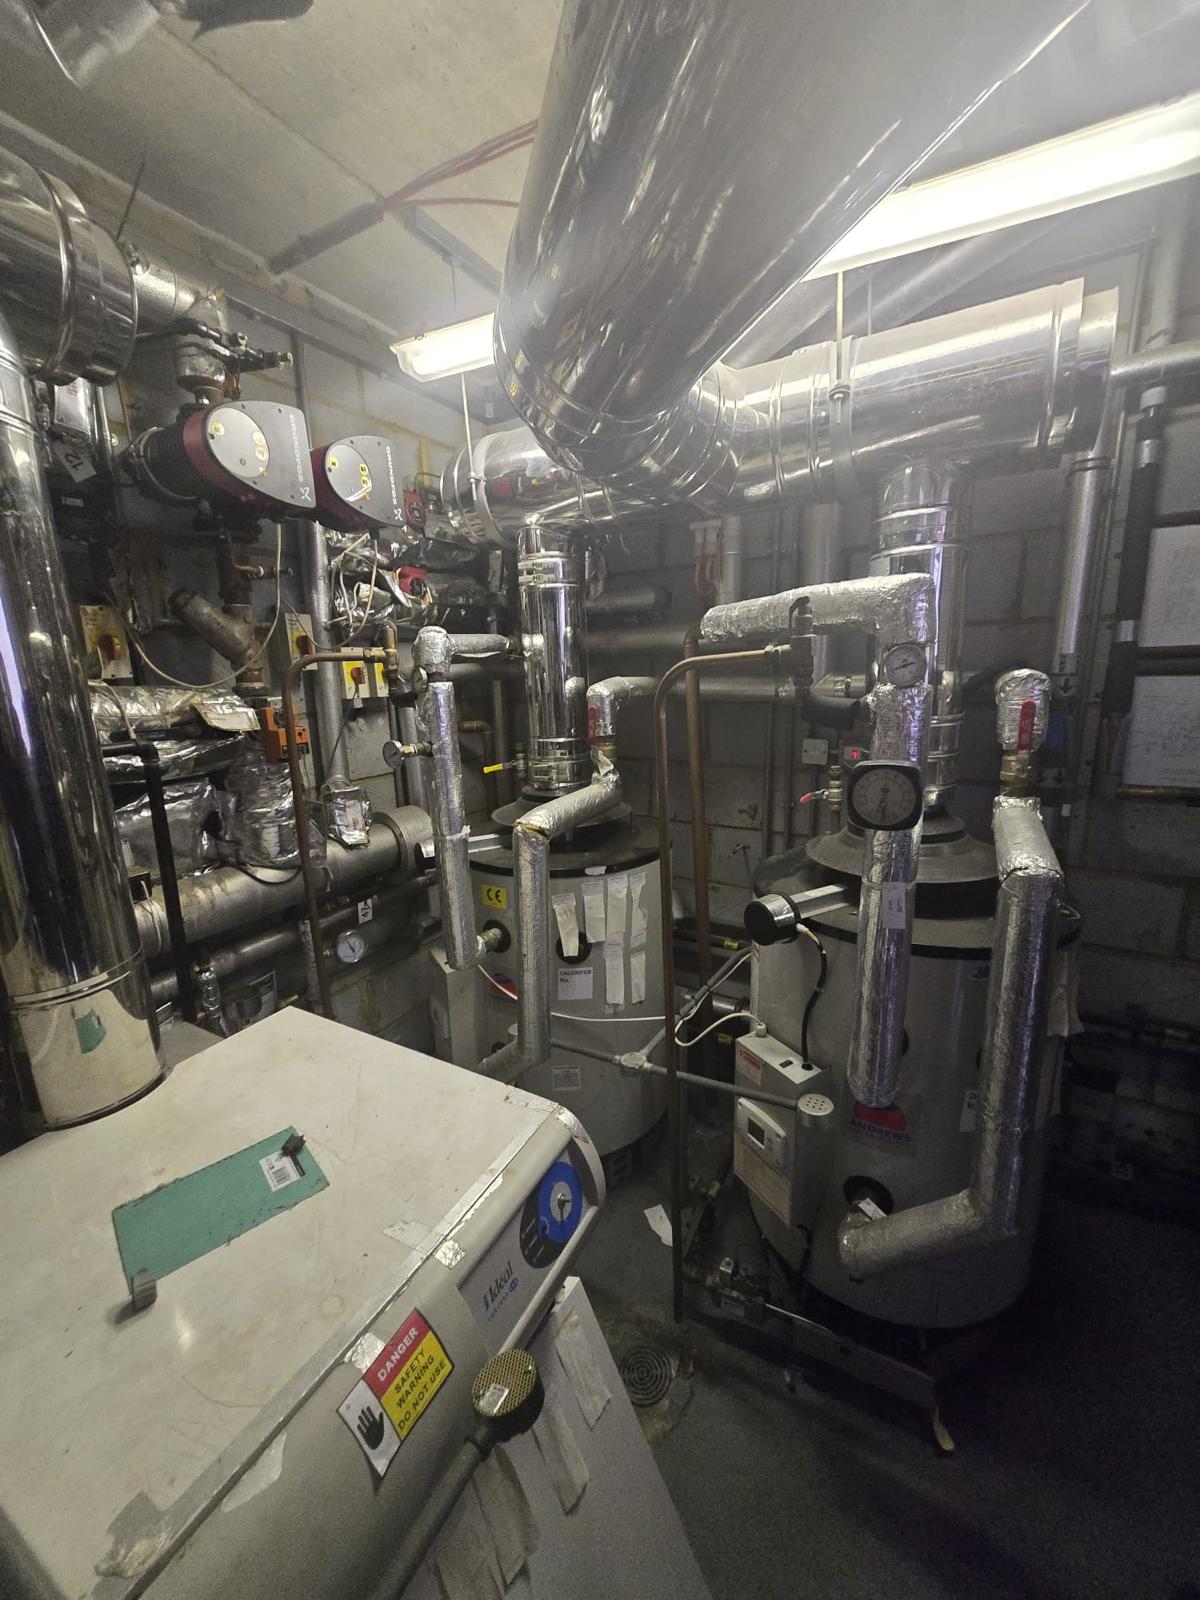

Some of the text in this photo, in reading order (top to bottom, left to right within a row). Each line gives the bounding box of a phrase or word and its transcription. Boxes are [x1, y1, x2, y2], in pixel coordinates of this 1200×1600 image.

[289, 413, 304, 482] GRUNDFOS
[386, 445, 398, 505] GRUNDFOS
[486, 888, 502, 903] CE
[377, 1327, 419, 1381] DANGER
[394, 1348, 425, 1393] SAFETY
[396, 1355, 434, 1409] WARNING
[397, 1360, 447, 1430] DO NOT USE
